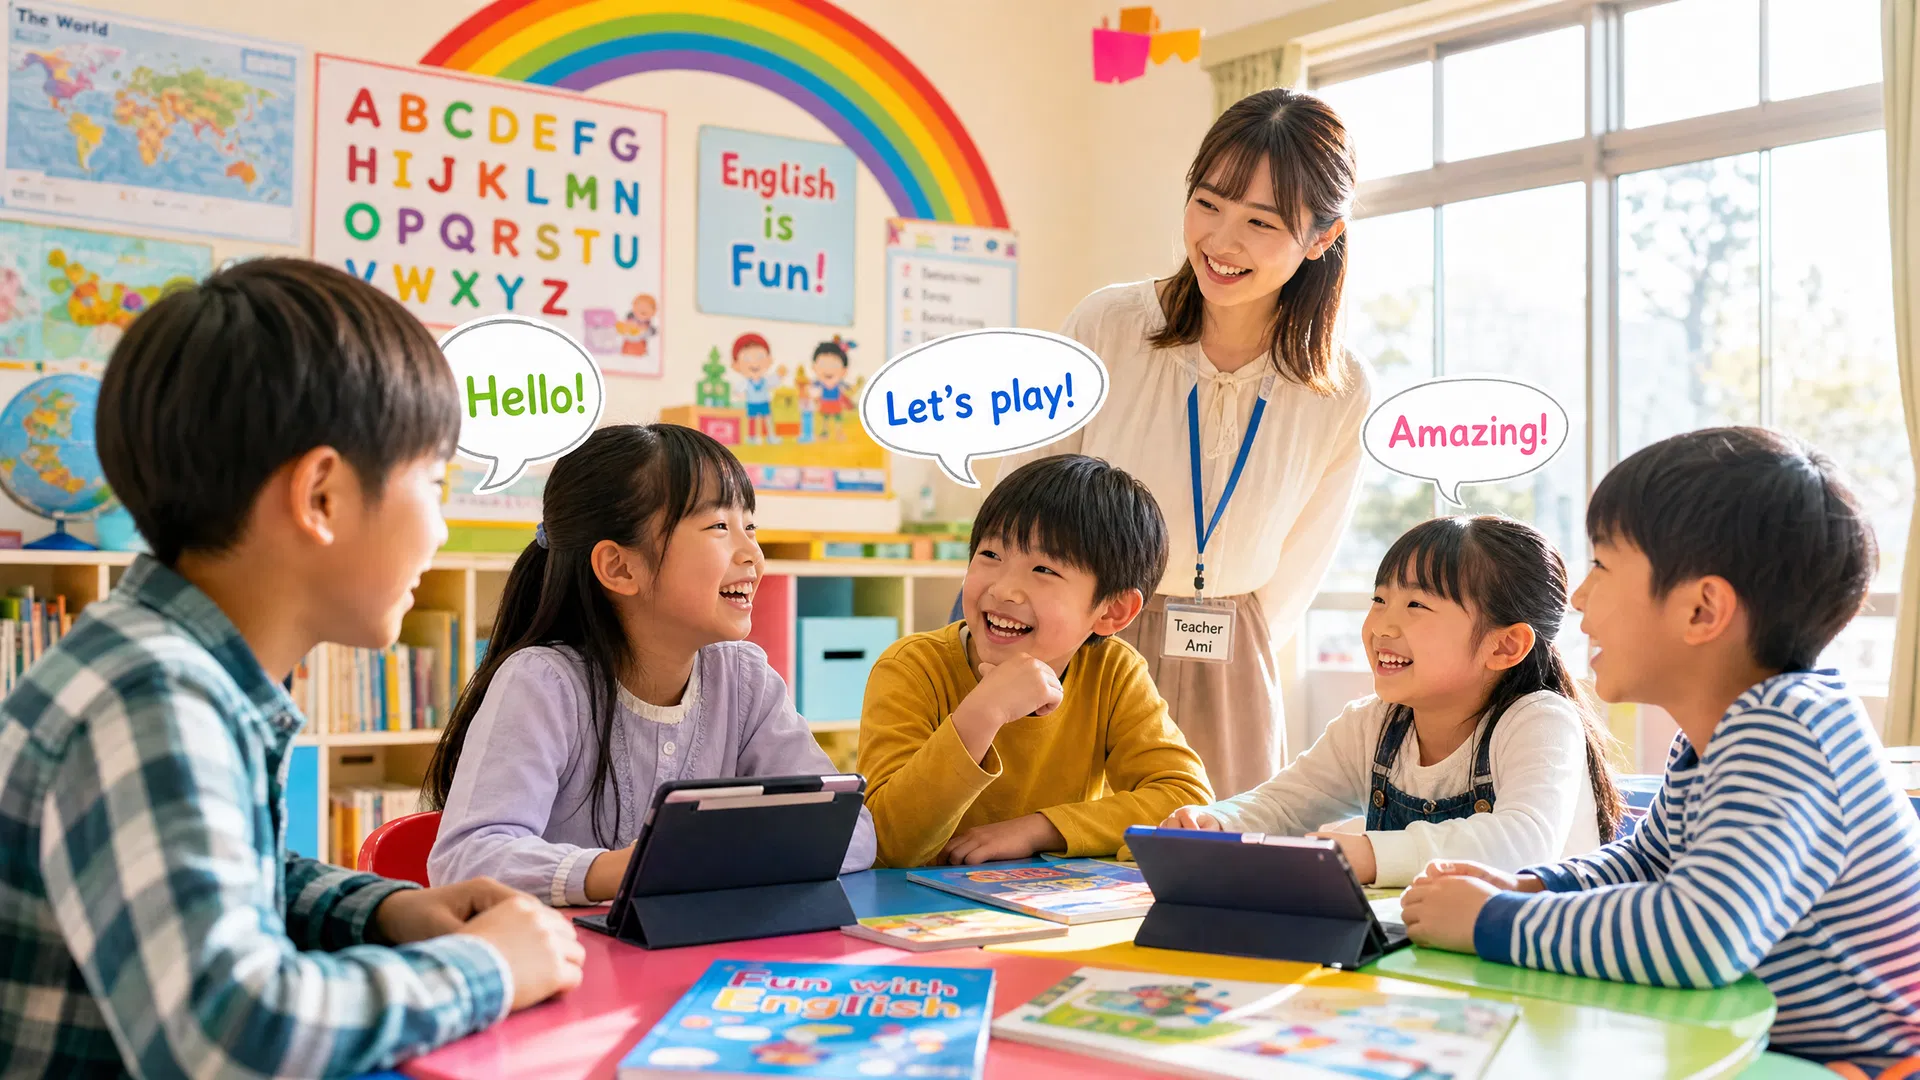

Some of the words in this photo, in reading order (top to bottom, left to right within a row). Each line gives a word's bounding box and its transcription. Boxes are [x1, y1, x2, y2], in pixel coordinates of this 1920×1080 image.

[16, 8, 49, 27] The
[56, 15, 108, 37] World
[346, 87, 381, 128] A
[399, 93, 429, 134] B
[443, 101, 474, 139] C
[488, 105, 519, 144] D
[532, 113, 557, 152] E
[573, 120, 597, 156] F
[609, 126, 640, 162] G
[348, 145, 377, 184] H
[393, 149, 413, 189] I
[427, 156, 455, 193] J
[478, 161, 507, 200] K
[526, 167, 549, 205] L
[566, 172, 597, 211] M
[614, 179, 639, 217] N
[722, 152, 835, 200] English
[344, 202, 381, 241] O
[398, 207, 425, 245] P
[439, 213, 476, 254] Q
[493, 218, 519, 257] R
[536, 223, 561, 261] S
[573, 227, 600, 266] T
[613, 233, 639, 270] U
[765, 205, 793, 241] is
[732, 243, 825, 293] Fun!
[393, 263, 436, 304] W
[450, 269, 480, 308] X
[496, 274, 524, 311] Y
[541, 279, 569, 316] Z
[1174, 618, 1224, 635] Teacher
[1185, 639, 1212, 653] Ami
[712, 987, 963, 1019] English
[729, 969, 833, 993] Fun
[850, 976, 959, 998] with
